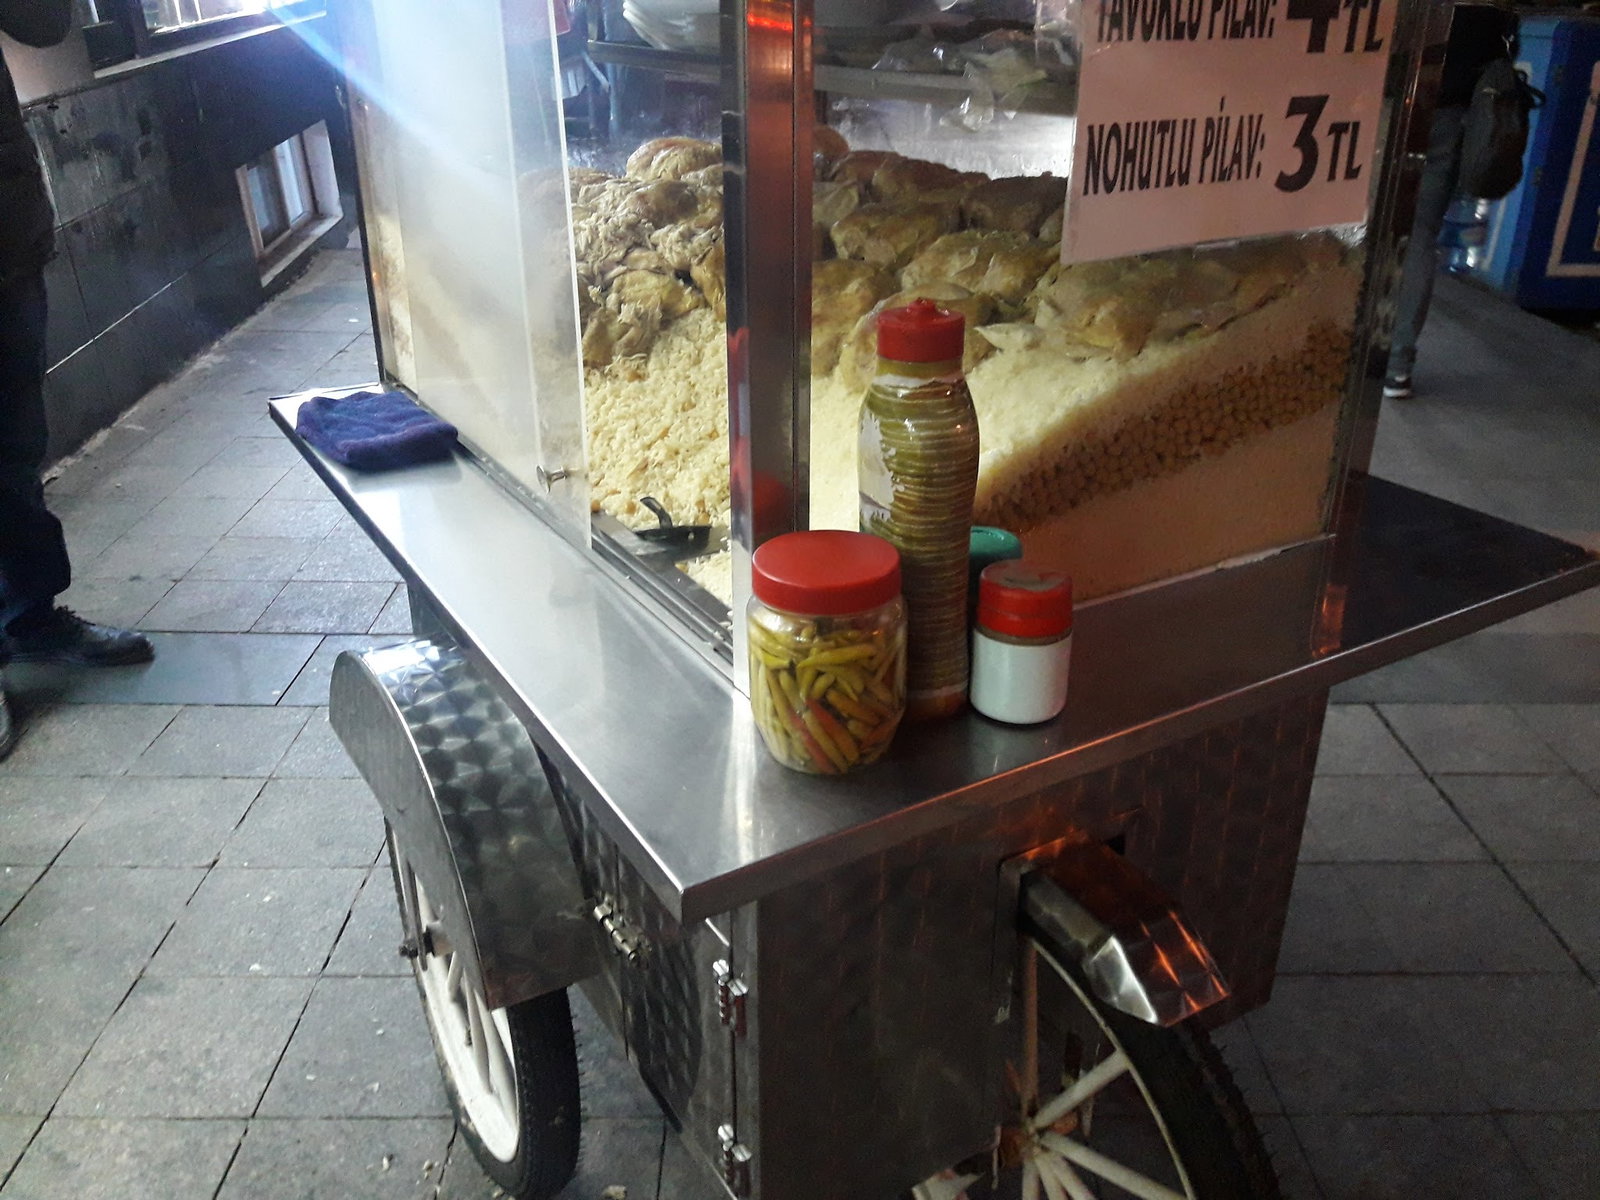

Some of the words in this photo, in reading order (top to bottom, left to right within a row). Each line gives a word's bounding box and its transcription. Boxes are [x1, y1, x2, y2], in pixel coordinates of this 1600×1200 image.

[1343, 0, 1383, 52] TL
[1083, 118, 1196, 196] NOHUTLU
[1198, 96, 1264, 184] PİLAV:
[1275, 95, 1330, 193] 3
[1327, 120, 1363, 182] TL
